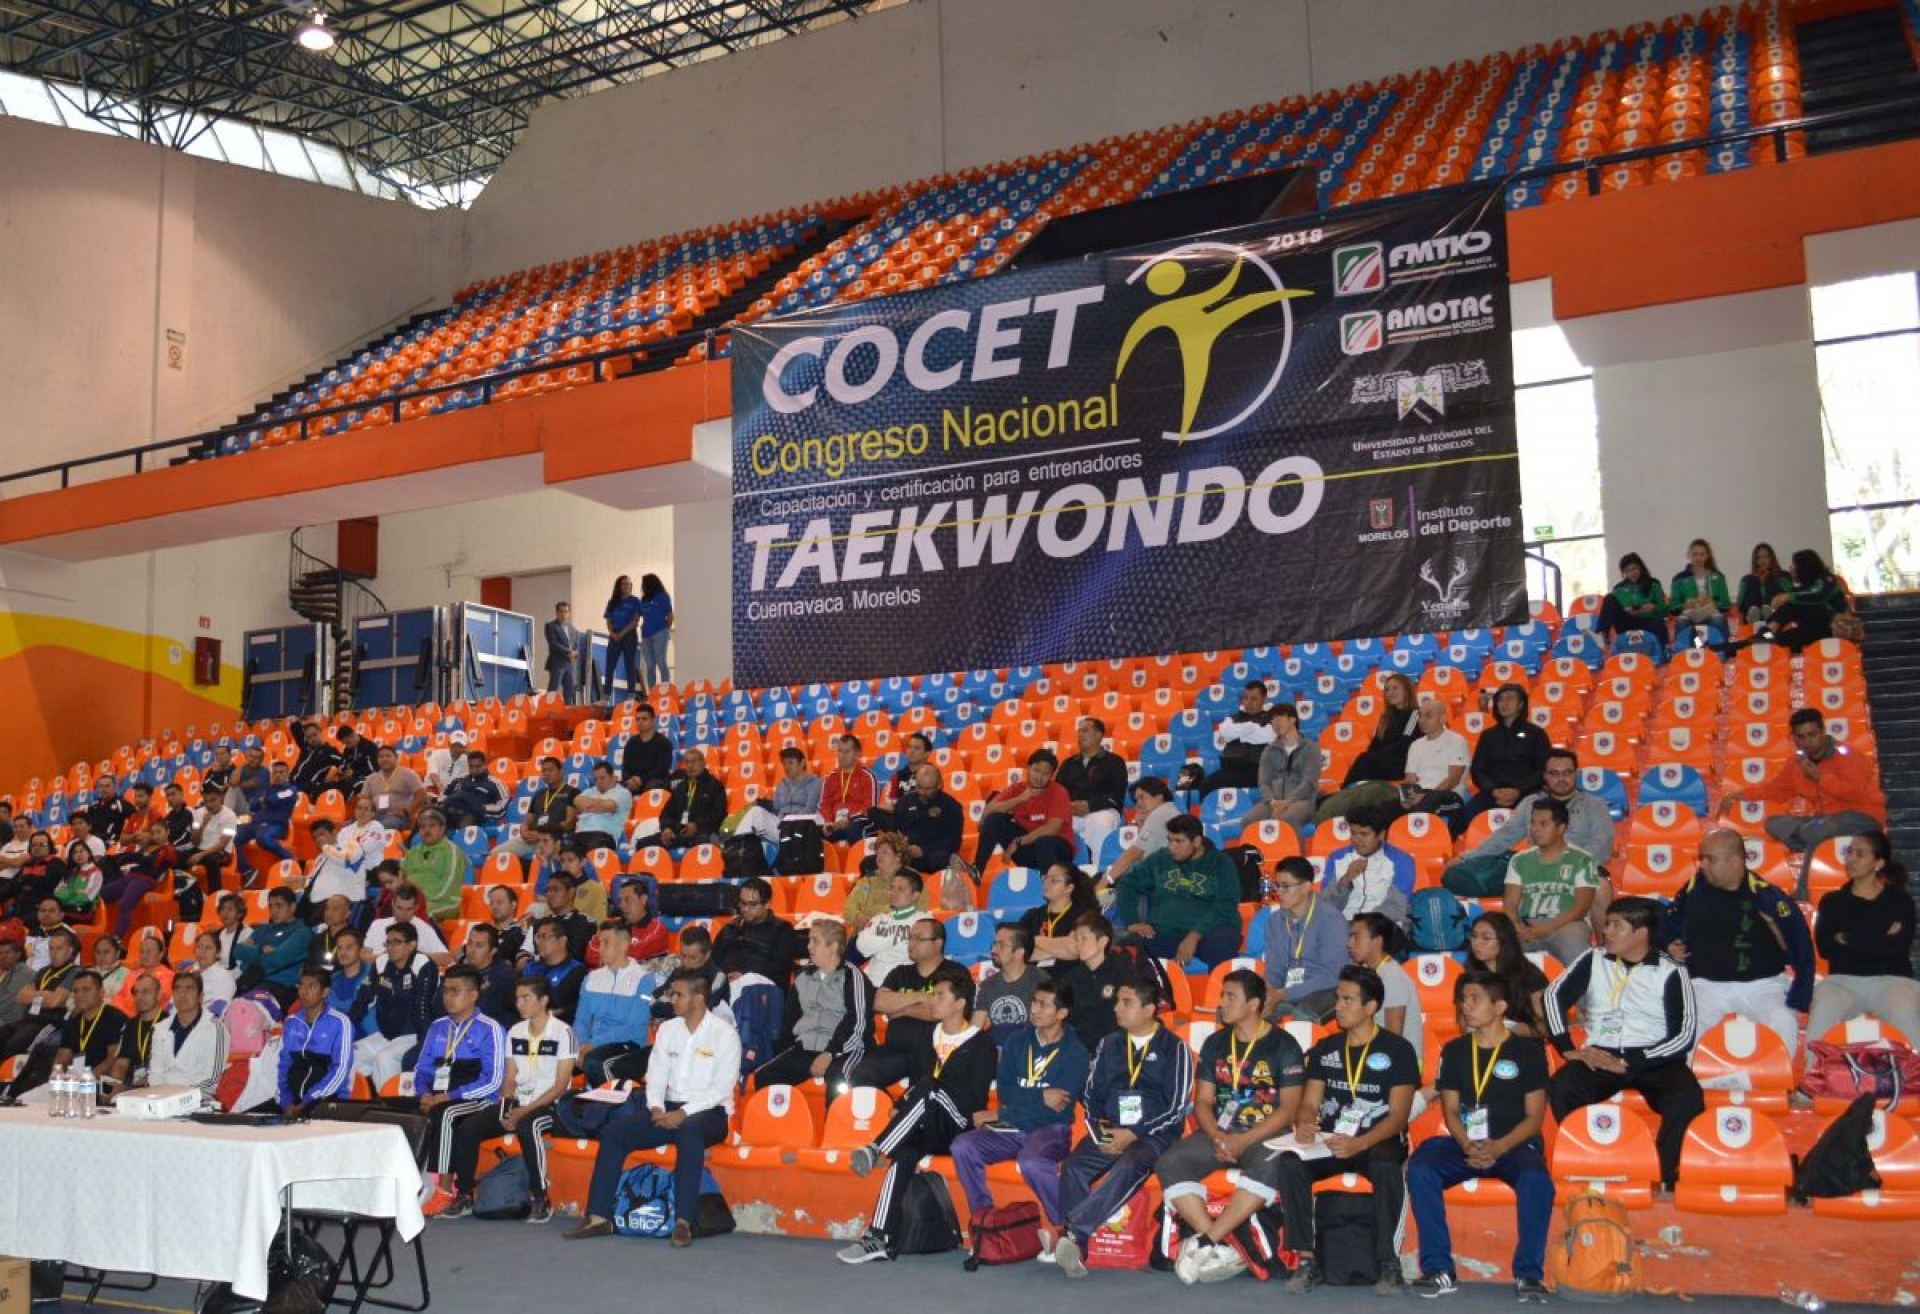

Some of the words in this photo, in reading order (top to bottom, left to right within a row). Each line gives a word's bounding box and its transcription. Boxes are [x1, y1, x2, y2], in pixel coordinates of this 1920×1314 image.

[1266, 229, 1323, 251] 2018
[1387, 294, 1493, 330] AMOTAC
[762, 285, 1105, 413] COCET
[752, 423, 929, 477] Congreso
[943, 383, 1119, 450] Nacional
[760, 488, 856, 518] Capacitación
[864, 490, 873, 508] y
[881, 473, 975, 501] certificación
[983, 469, 1020, 492] para
[1029, 453, 1142, 482] entrenadores
[743, 455, 1325, 591] TAEKWONDO
[1417, 504, 1474, 521] Instituto
[1420, 521, 1444, 536] del
[1448, 515, 1512, 534] Deporte
[1358, 529, 1409, 543] MORELOS
[748, 596, 844, 621] Cuernavaca
[852, 586, 921, 609] Morelos
[1529, 893, 1560, 917] 14
